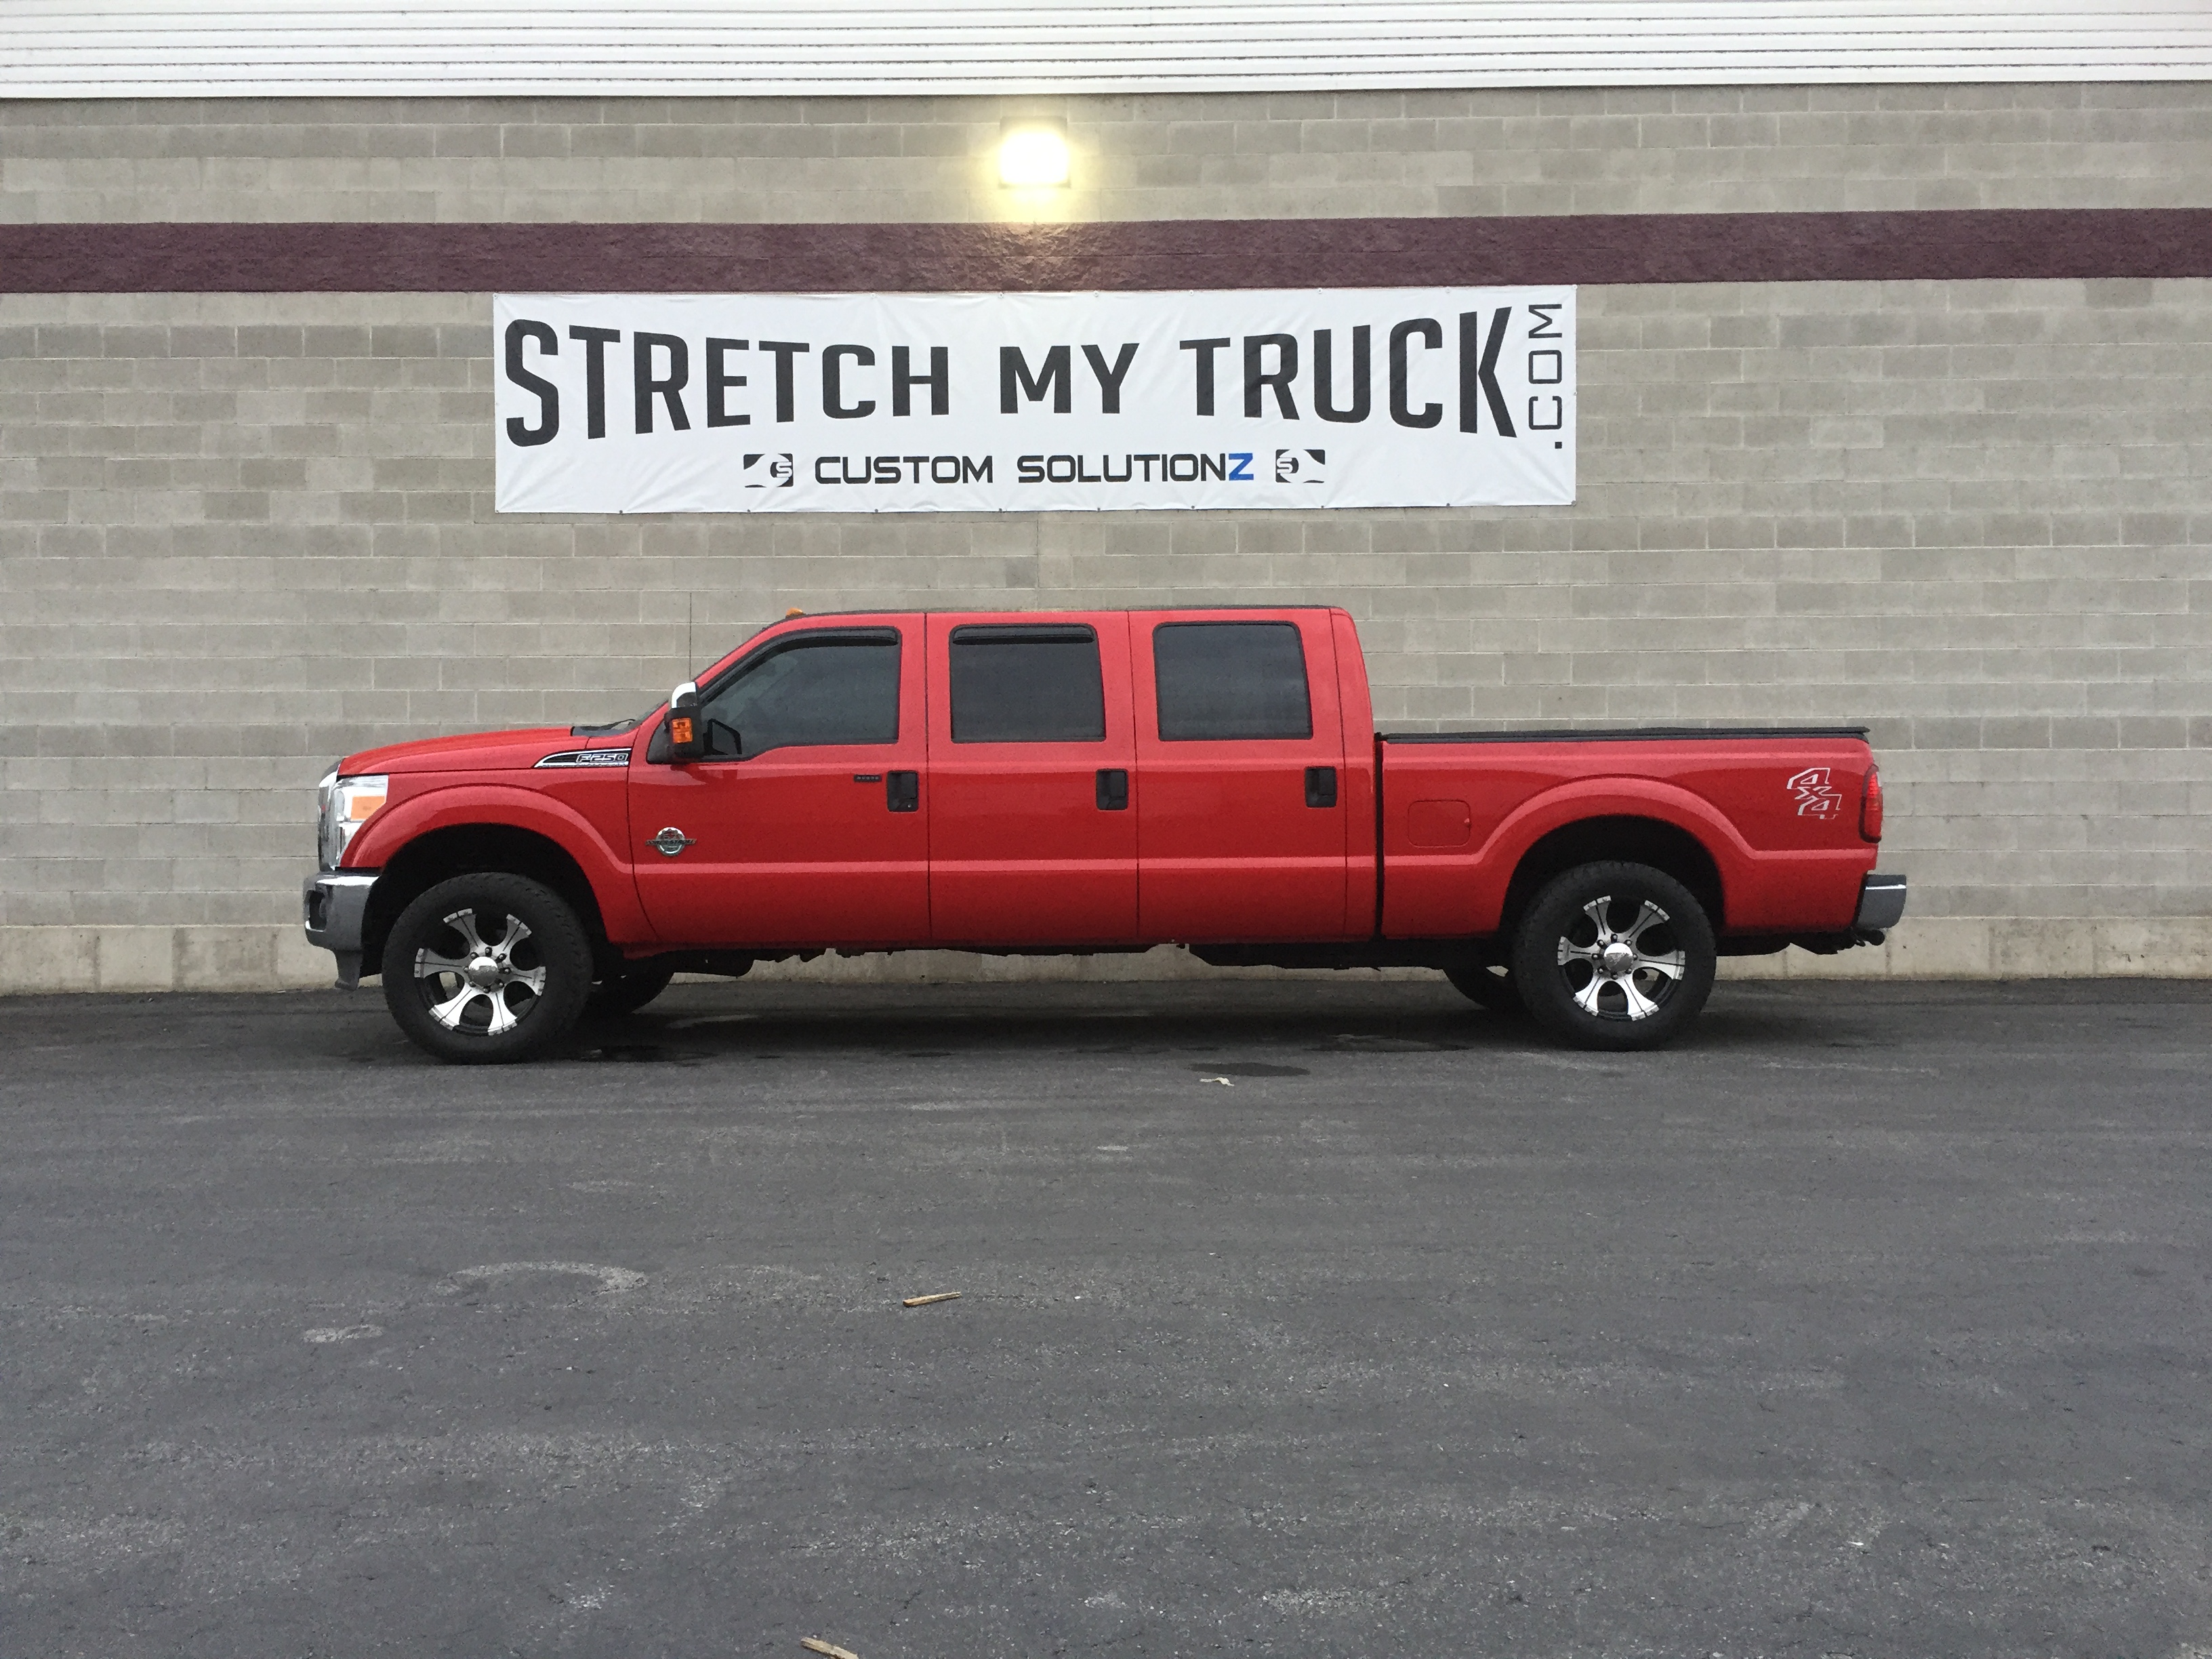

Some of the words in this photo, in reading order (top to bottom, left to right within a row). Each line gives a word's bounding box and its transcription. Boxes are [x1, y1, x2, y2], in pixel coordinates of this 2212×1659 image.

[506, 319, 949, 447] STRETCH
[1000, 343, 1140, 414] MY
[1179, 306, 1517, 438] TRUCK
[1528, 304, 1563, 449] .COM
[815, 455, 994, 485] CUSTOM
[1017, 453, 1254, 483] SOLUTIONZ
